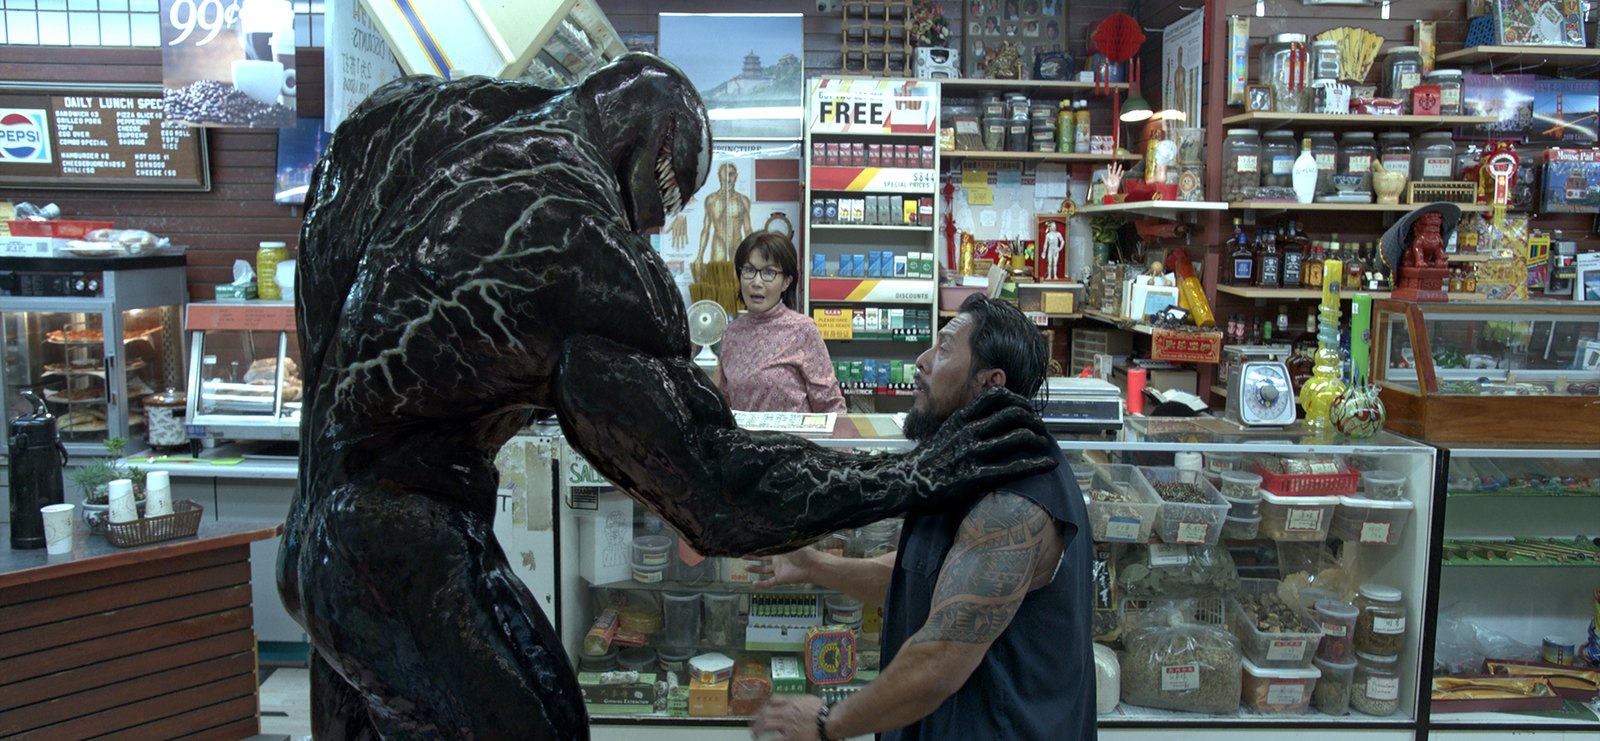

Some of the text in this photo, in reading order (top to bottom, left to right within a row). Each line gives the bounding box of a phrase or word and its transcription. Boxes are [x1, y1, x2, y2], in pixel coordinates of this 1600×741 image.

[168, 0, 240, 46] 99¢
[64, 96, 93, 108] DAILY
[98, 97, 134, 110] LUNCH
[820, 102, 883, 124] FREE
[0, 130, 40, 142] PEPSI
[1558, 151, 1594, 161] Mouse Pad
